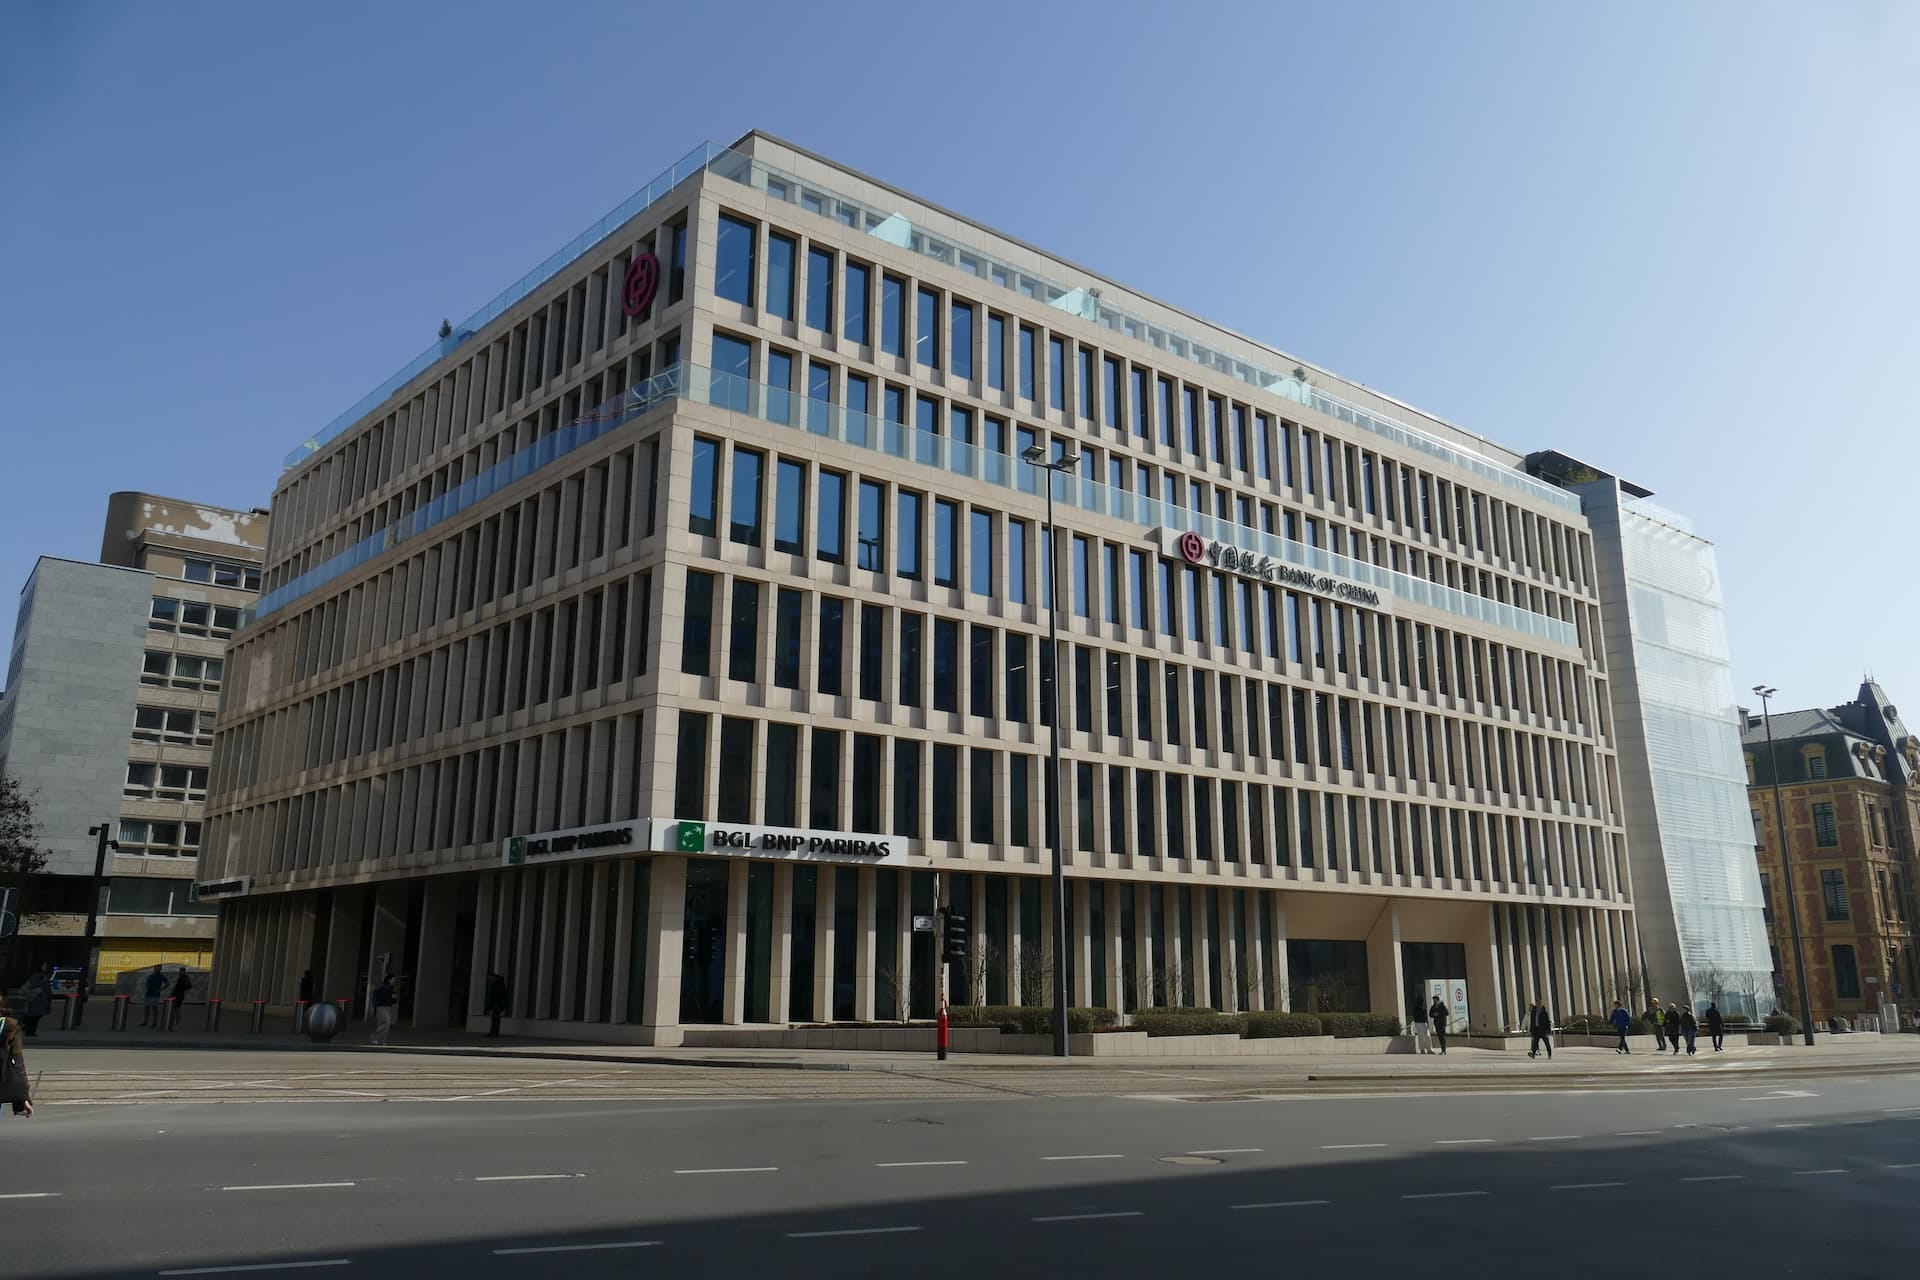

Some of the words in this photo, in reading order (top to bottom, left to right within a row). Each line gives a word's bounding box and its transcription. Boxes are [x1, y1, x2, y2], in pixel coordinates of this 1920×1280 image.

[1280, 564, 1316, 588] BANK
[1317, 577, 1336, 592] OF
[1337, 583, 1380, 605] CHINA
[713, 830, 756, 849] BGL
[763, 833, 805, 851] BNP
[809, 837, 890, 857] PARIBAS
